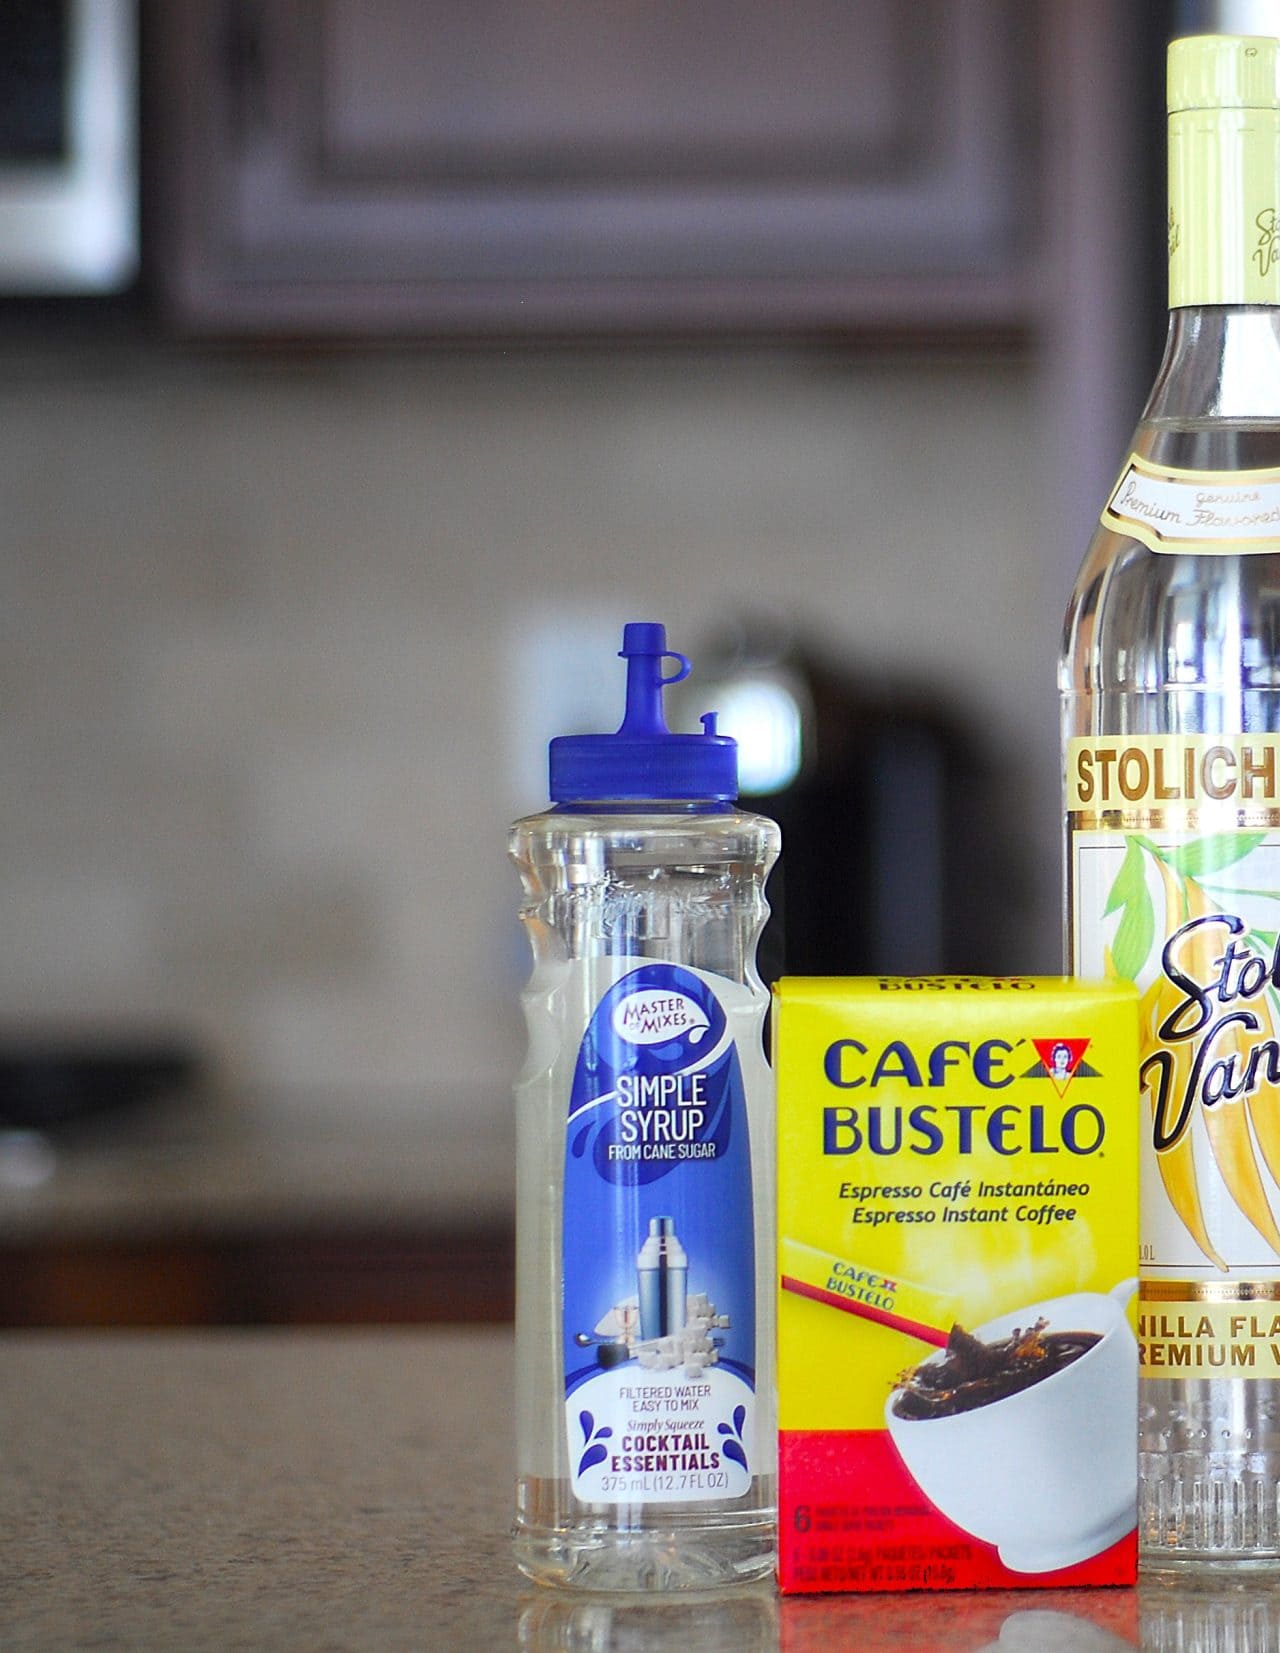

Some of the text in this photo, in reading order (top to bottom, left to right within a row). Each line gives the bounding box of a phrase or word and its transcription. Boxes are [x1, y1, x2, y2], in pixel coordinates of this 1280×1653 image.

[1120, 481, 1182, 524] Premium
[1196, 492, 1260, 504] Genuine
[623, 999, 684, 1024] MASTER
[641, 1013, 686, 1033] MIXES
[616, 1074, 707, 1107] SIMPLE
[620, 1109, 704, 1142] SYRUP
[822, 1104, 1106, 1157] BUSTELO
[608, 1144, 716, 1160] FROM CANE SUGAR
[839, 1180, 1090, 1201] Espresso Café Instantáneo
[852, 1204, 1077, 1227] Espresso Instant Coffee
[827, 1277, 895, 1311] BUSTELO
[620, 1385, 711, 1399] FILTERED WATER
[633, 1399, 699, 1412] EASY TO MIX
[627, 1419, 705, 1433] Simply Squeeze
[622, 1434, 710, 1452] COCKTAIL
[611, 1452, 720, 1472] ESSENTIALS
[601, 1473, 729, 1491] 375 mL (12.7 FL OZ)
[794, 1505, 811, 1533] 6
